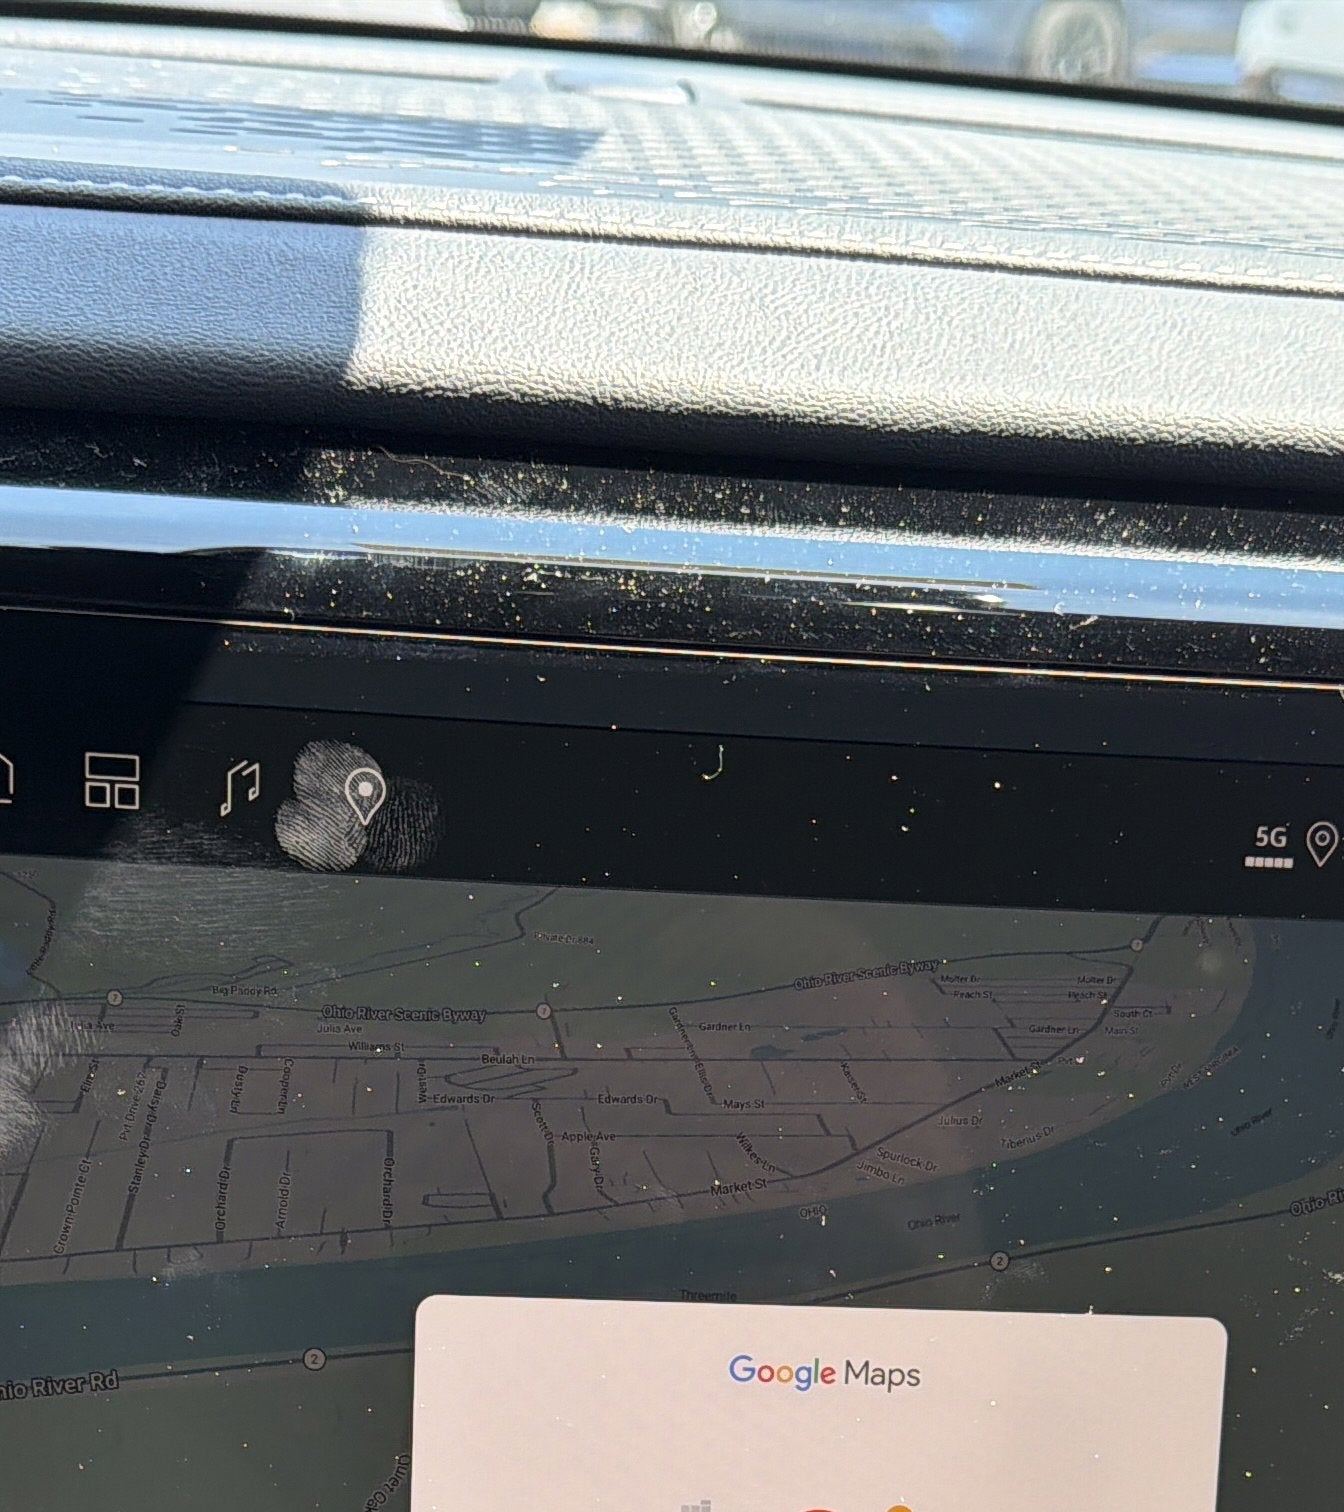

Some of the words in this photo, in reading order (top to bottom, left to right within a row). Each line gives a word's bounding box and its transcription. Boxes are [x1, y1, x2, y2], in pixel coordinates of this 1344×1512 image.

[1255, 825, 1288, 849] 5G
[823, 972, 855, 987] River
[859, 965, 898, 980] Scenic
[900, 958, 940, 977] Byway
[322, 1005, 354, 1020] Ohio
[357, 1006, 392, 1021] River
[394, 1008, 440, 1022] Scenic
[442, 1009, 487, 1025] Byway
[698, 1021, 735, 1032] Gardner
[482, 1053, 518, 1065] Beulah
[520, 1054, 535, 1065] Ln
[432, 1093, 480, 1104] Edwards
[482, 1093, 496, 1104] Dr
[598, 1094, 642, 1105] Edwards
[644, 1094, 659, 1105] Dr
[723, 1098, 748, 1112] Mays
[750, 1099, 766, 1110] St
[971, 1114, 984, 1126] Dr
[138, 1135, 152, 1151] Dr
[561, 1131, 593, 1144] Apple
[594, 1131, 616, 1142] Ave
[735, 1131, 763, 1163] Wilkes
[1000, 1131, 1042, 1149] Tiberius
[1042, 1125, 1056, 1139] Dr
[876, 1147, 922, 1169] Spurlock
[923, 1158, 939, 1173] Dr
[127, 1150, 150, 1194] Stanley
[218, 1164, 233, 1182] Dr
[279, 1170, 291, 1188] Dr
[382, 1157, 395, 1208] Orchard
[856, 1160, 889, 1182] Jimbo
[891, 1172, 906, 1186] Ln
[710, 1180, 750, 1196] Market
[751, 1177, 768, 1190] St
[54, 1213, 76, 1255] Crown
[66, 1174, 88, 1213] Pointe
[214, 1182, 231, 1231] Orchard
[274, 1188, 291, 1229] Arnold
[1289, 1196, 1326, 1217] Ohio
[381, 1209, 394, 1227] Dr
[32, 1376, 86, 1398] River
[89, 1370, 120, 1391] Rd
[728, 1354, 837, 1393] Google
[844, 1359, 921, 1394] Maps
[384, 1454, 412, 1493] Quiet
